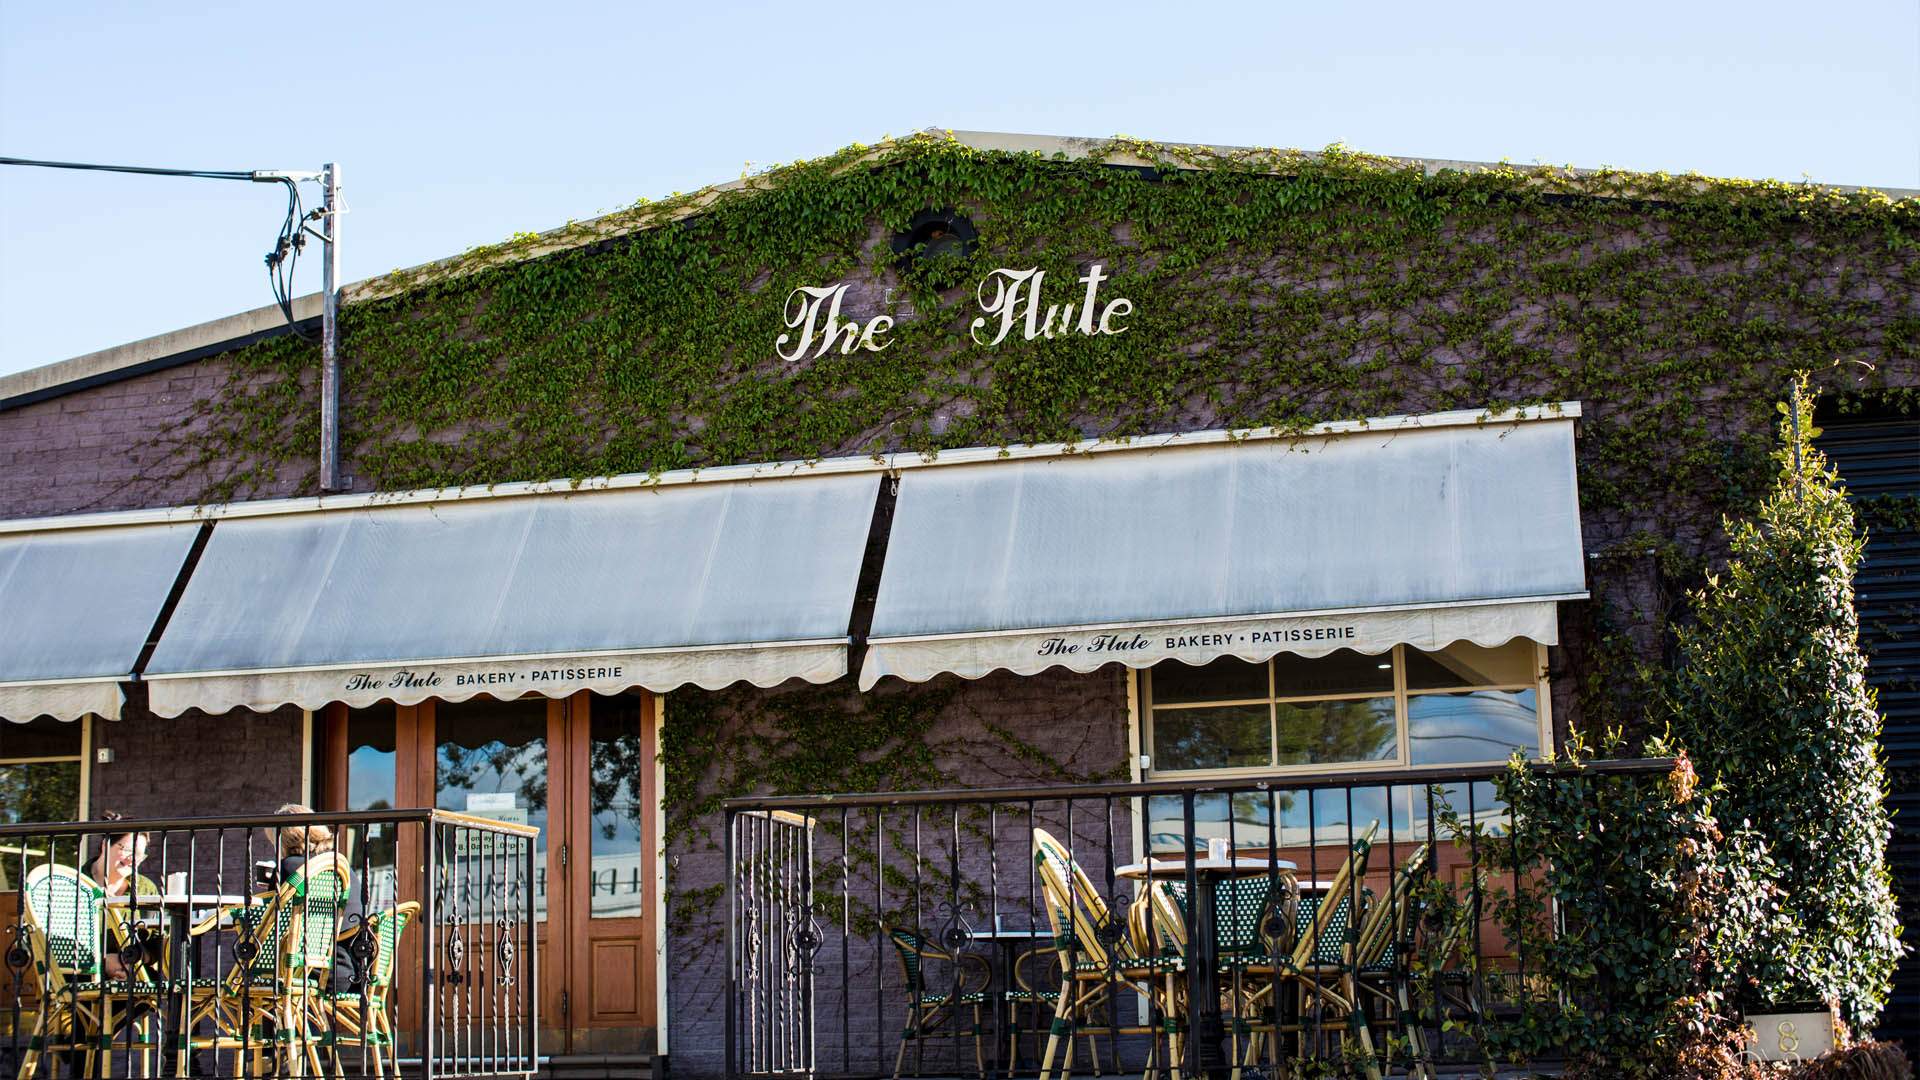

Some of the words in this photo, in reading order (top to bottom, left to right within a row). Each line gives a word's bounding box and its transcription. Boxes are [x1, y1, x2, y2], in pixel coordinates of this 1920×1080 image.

[775, 283, 895, 362] The
[971, 264, 1133, 346] Flute
[1038, 637, 1083, 656] The
[1087, 633, 1152, 652] Flute
[1166, 633, 1233, 649] BAKERY
[1251, 626, 1355, 643] PATISSERIE
[345, 674, 385, 691] The
[388, 671, 444, 689] Flute
[457, 672, 516, 686] BAKERY
[531, 666, 623, 681] PATISSERIE
